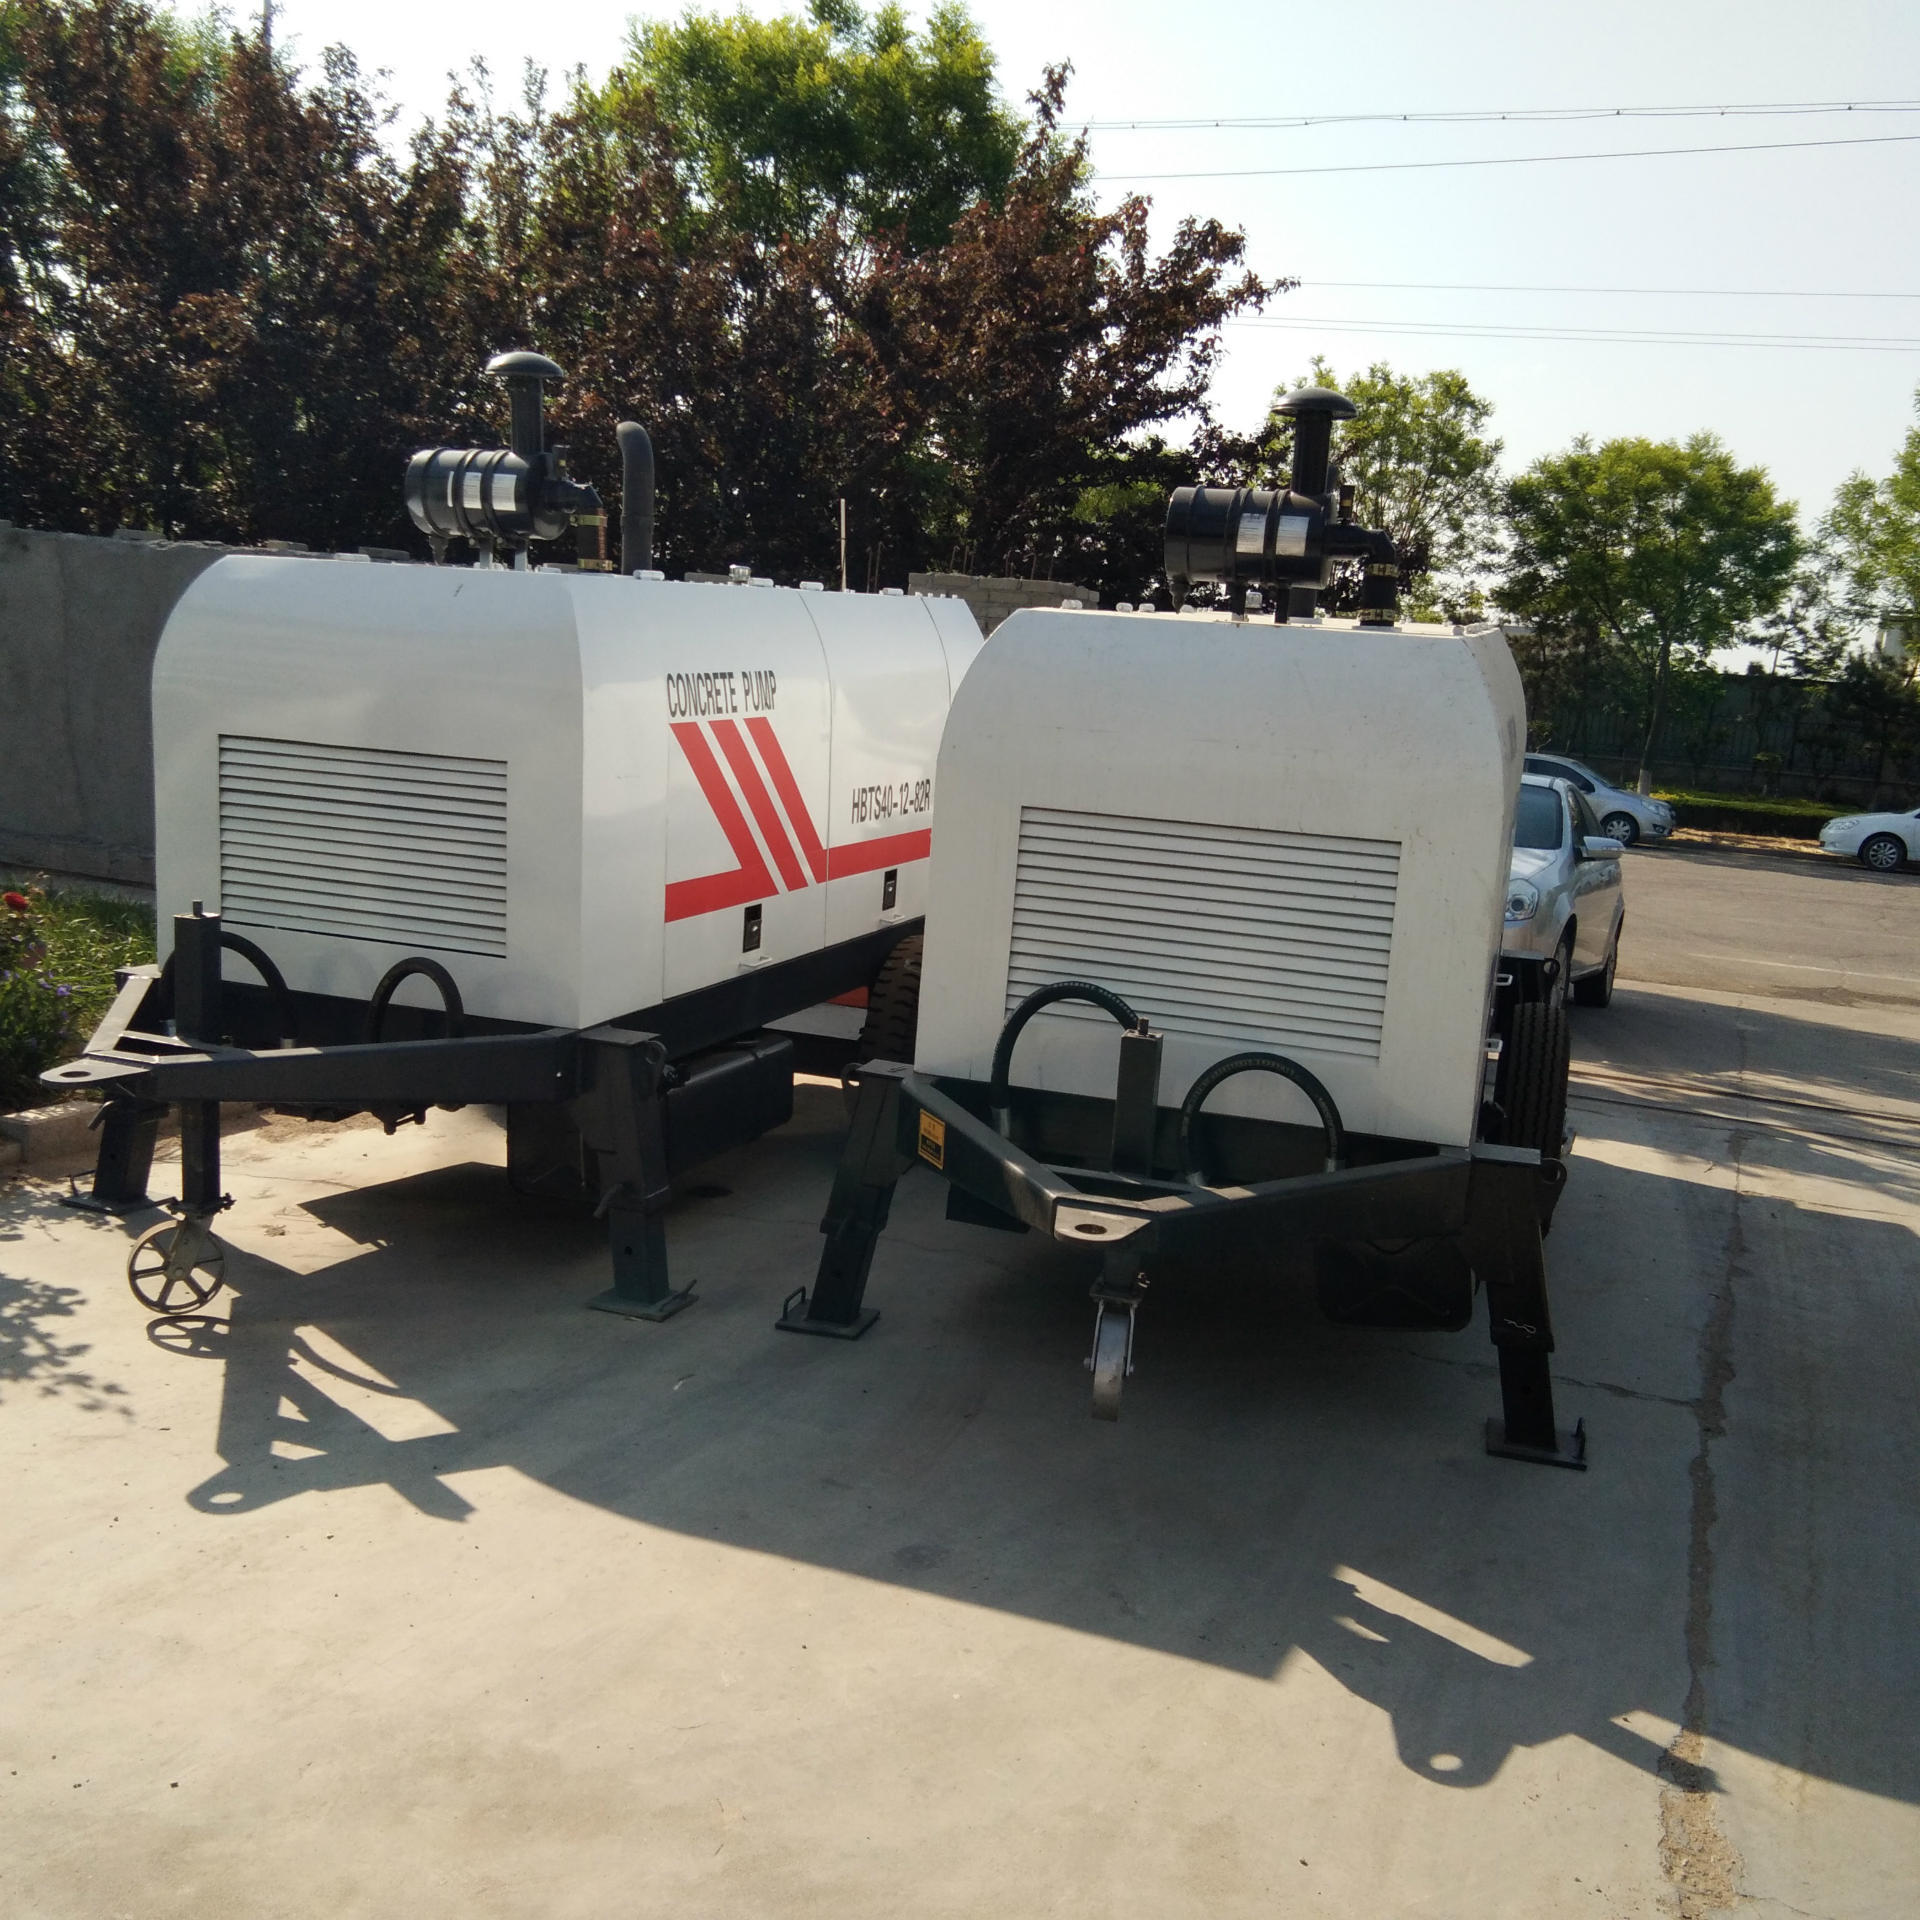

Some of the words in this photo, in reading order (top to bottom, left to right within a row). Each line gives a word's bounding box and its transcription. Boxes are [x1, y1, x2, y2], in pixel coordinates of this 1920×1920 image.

[666, 672, 738, 718] CONCRETE
[741, 670, 777, 712] PUMP
[851, 778, 931, 824] HBTS40-12-82R
